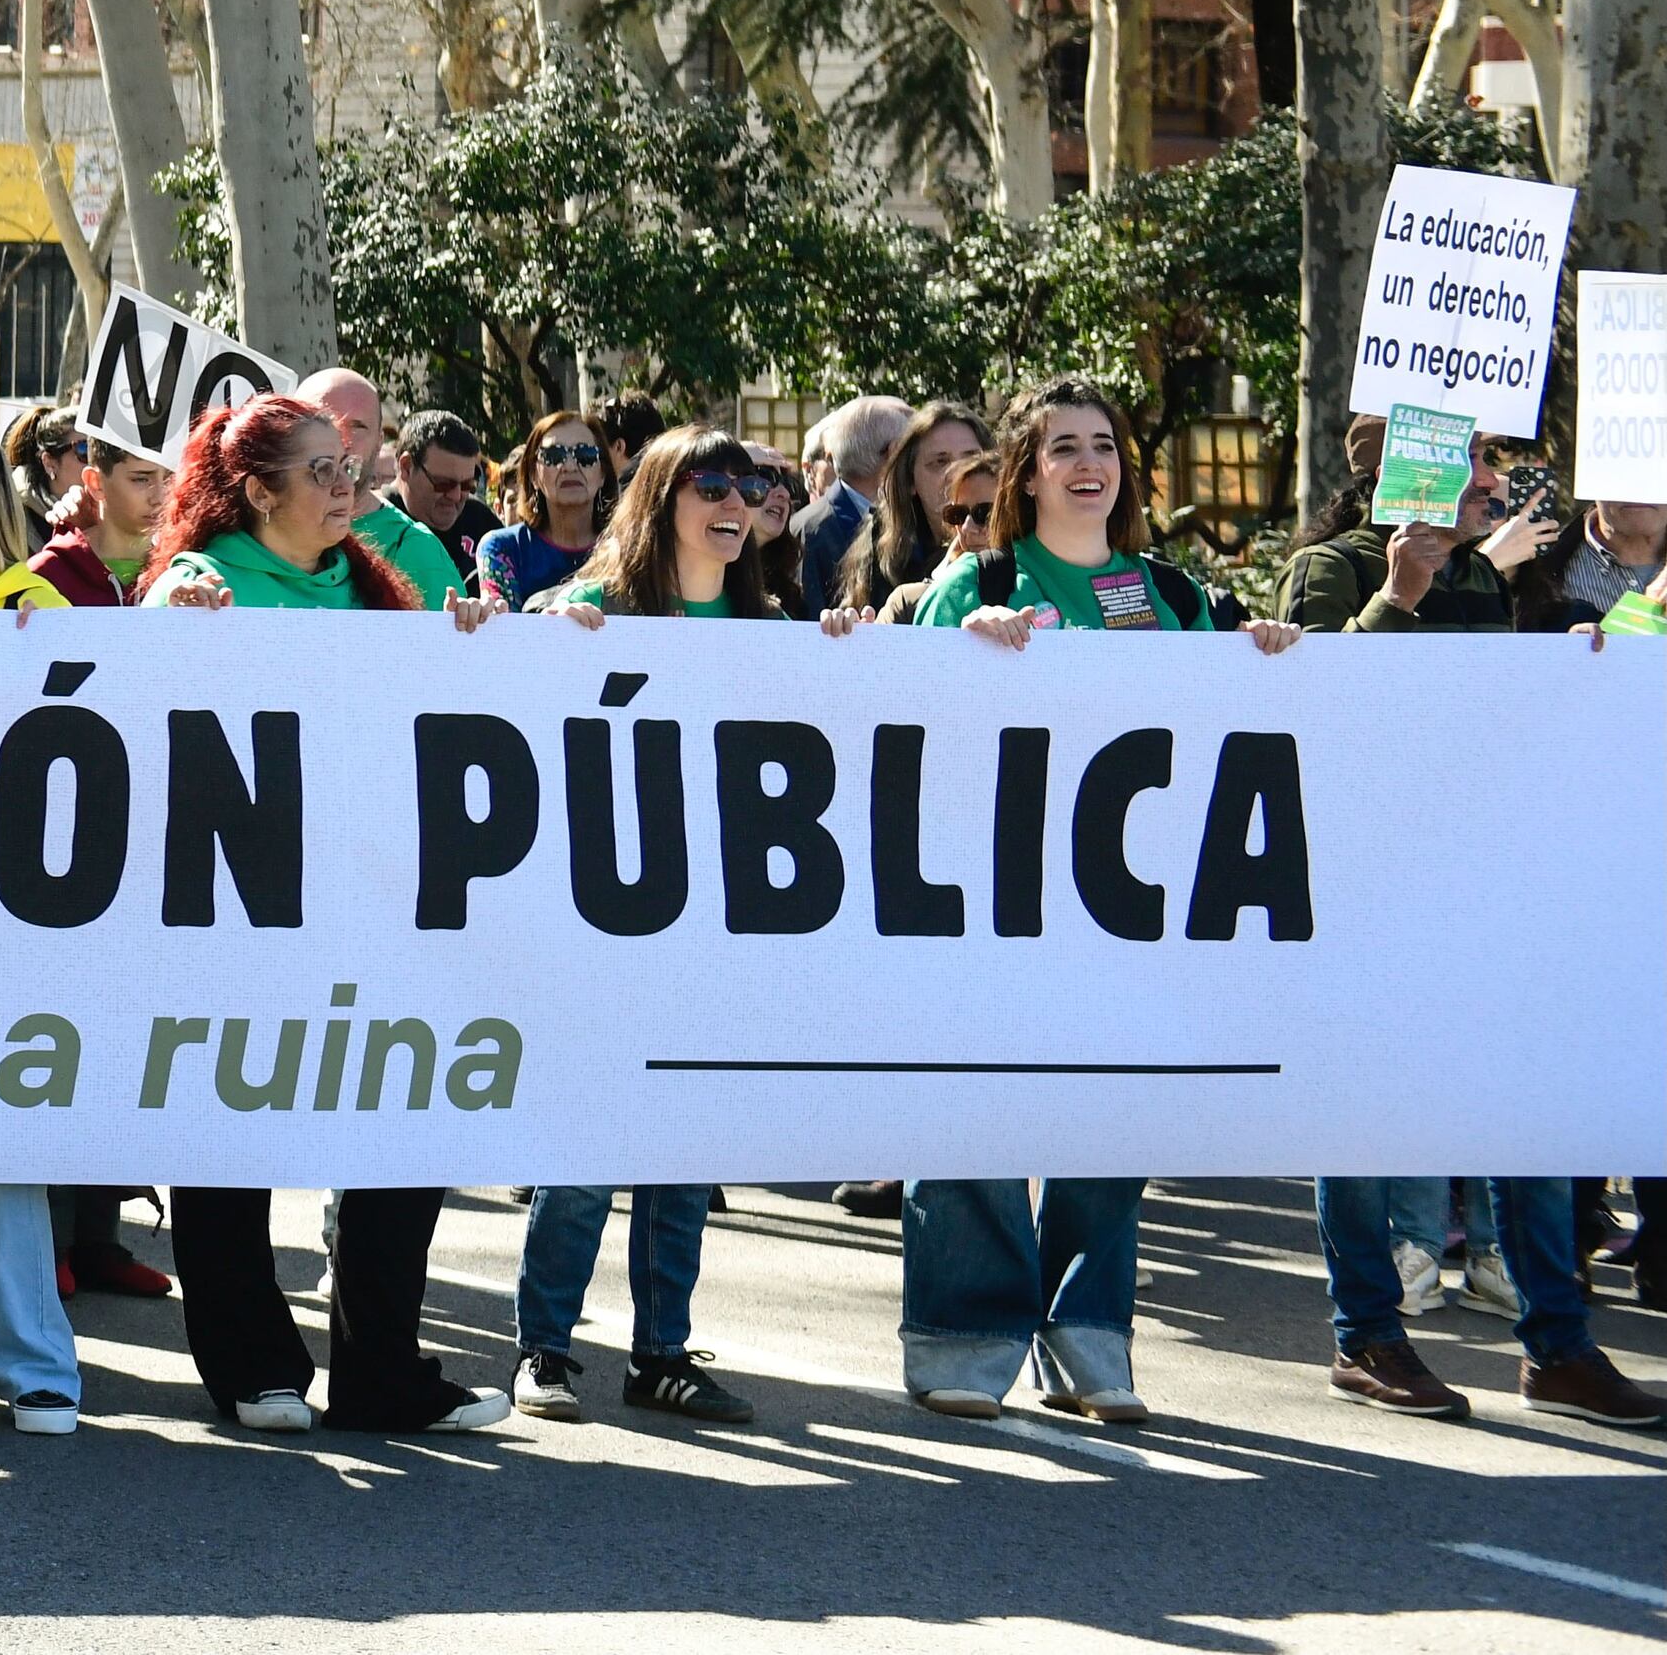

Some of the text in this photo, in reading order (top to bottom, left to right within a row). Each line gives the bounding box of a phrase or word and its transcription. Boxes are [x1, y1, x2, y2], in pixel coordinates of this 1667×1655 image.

[1383, 200, 1549, 272] La educación,
[1382, 271, 1531, 333] un derecho,
[1363, 335, 1536, 389] no negocio!
[414, 672, 1313, 941] PÚBLICA
[138, 983, 522, 1112] ruina
